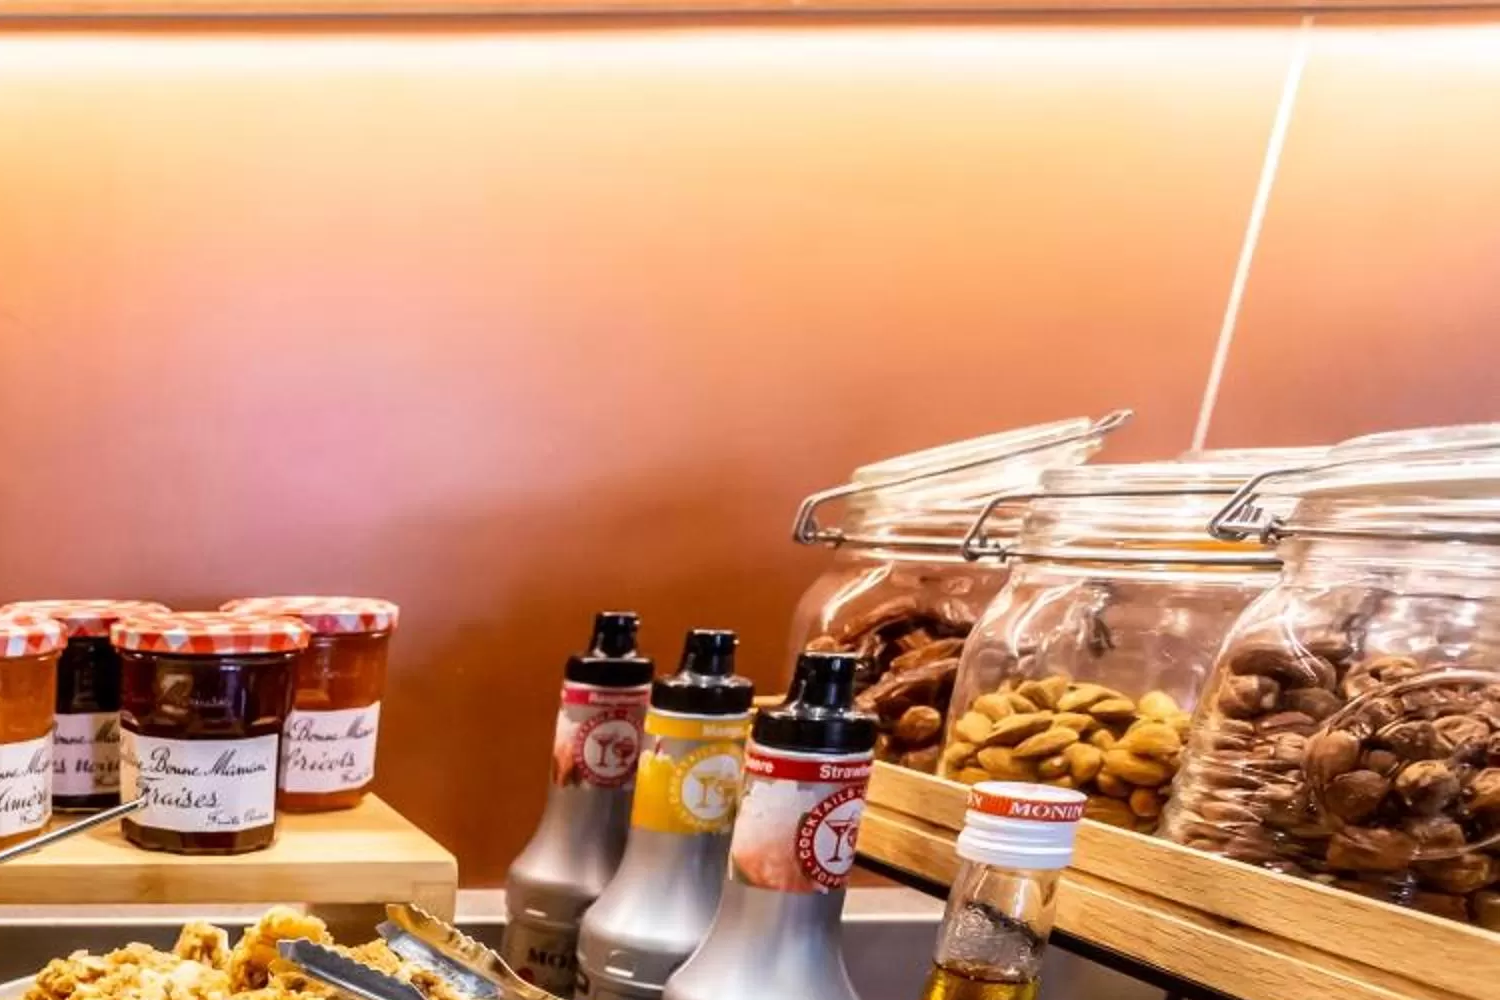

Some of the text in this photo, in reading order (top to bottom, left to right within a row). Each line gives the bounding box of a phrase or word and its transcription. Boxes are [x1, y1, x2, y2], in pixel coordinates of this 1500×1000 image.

[142, 744, 201, 776] Bonne
[203, 748, 268, 777] Maman
[136, 776, 220, 810] Fraises
[1010, 800, 1084, 819] MONIN
